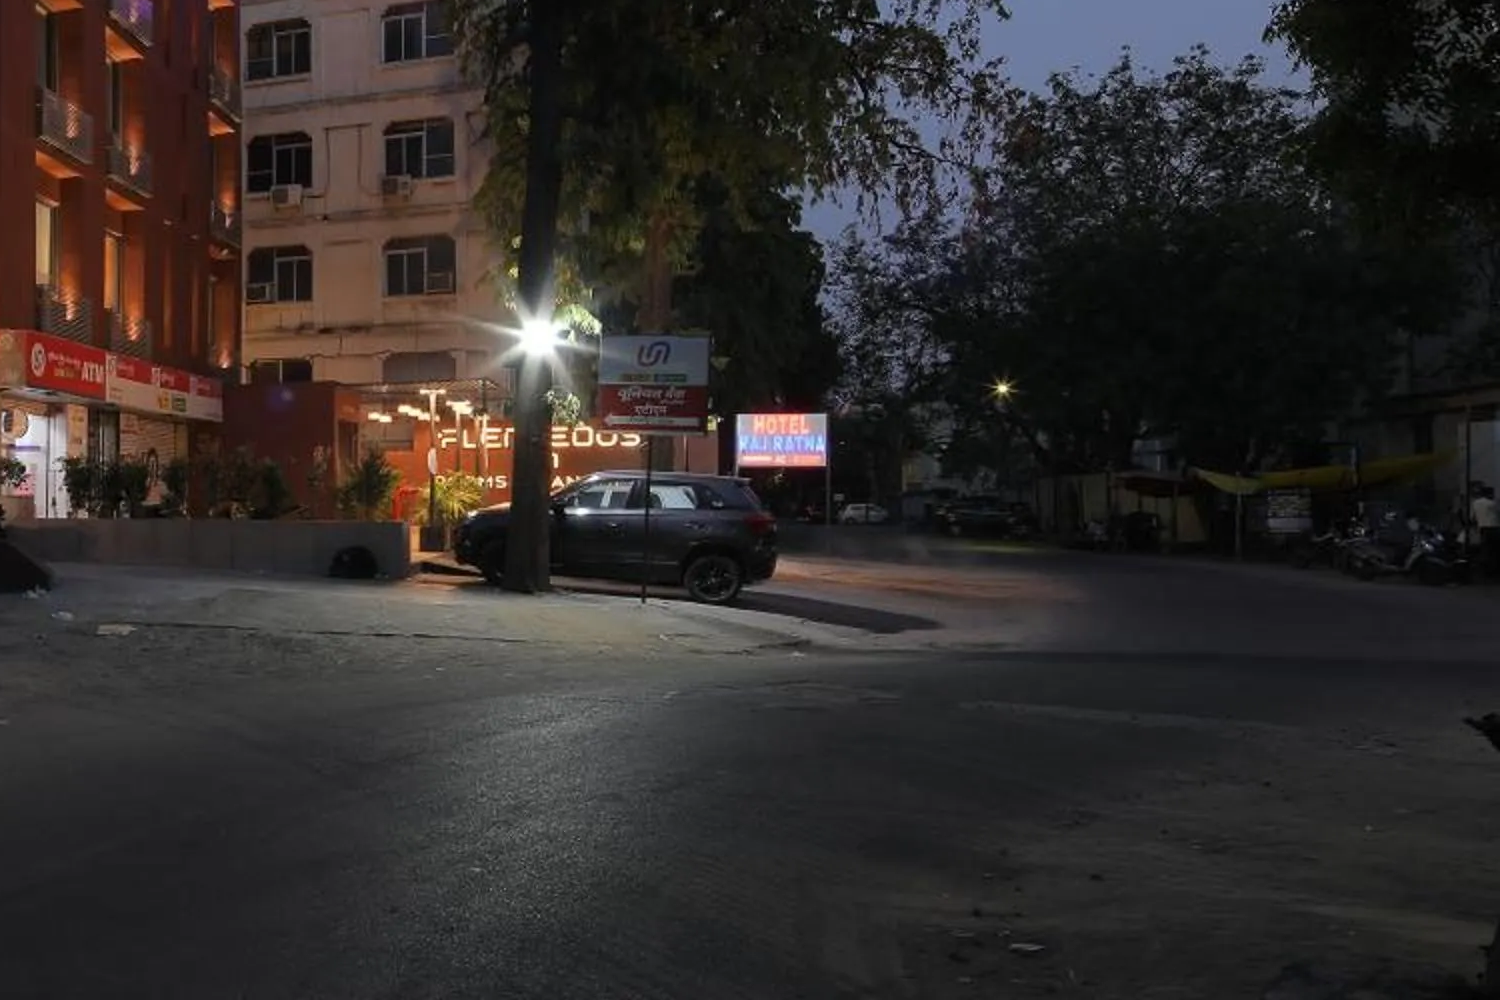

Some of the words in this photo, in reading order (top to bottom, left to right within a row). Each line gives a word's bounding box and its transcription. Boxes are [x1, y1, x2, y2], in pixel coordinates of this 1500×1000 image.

[81, 361, 104, 383] ATM
[753, 414, 810, 435] HOTEL
[439, 426, 641, 448] PLENEOUS
[773, 435, 825, 453] RATNA
